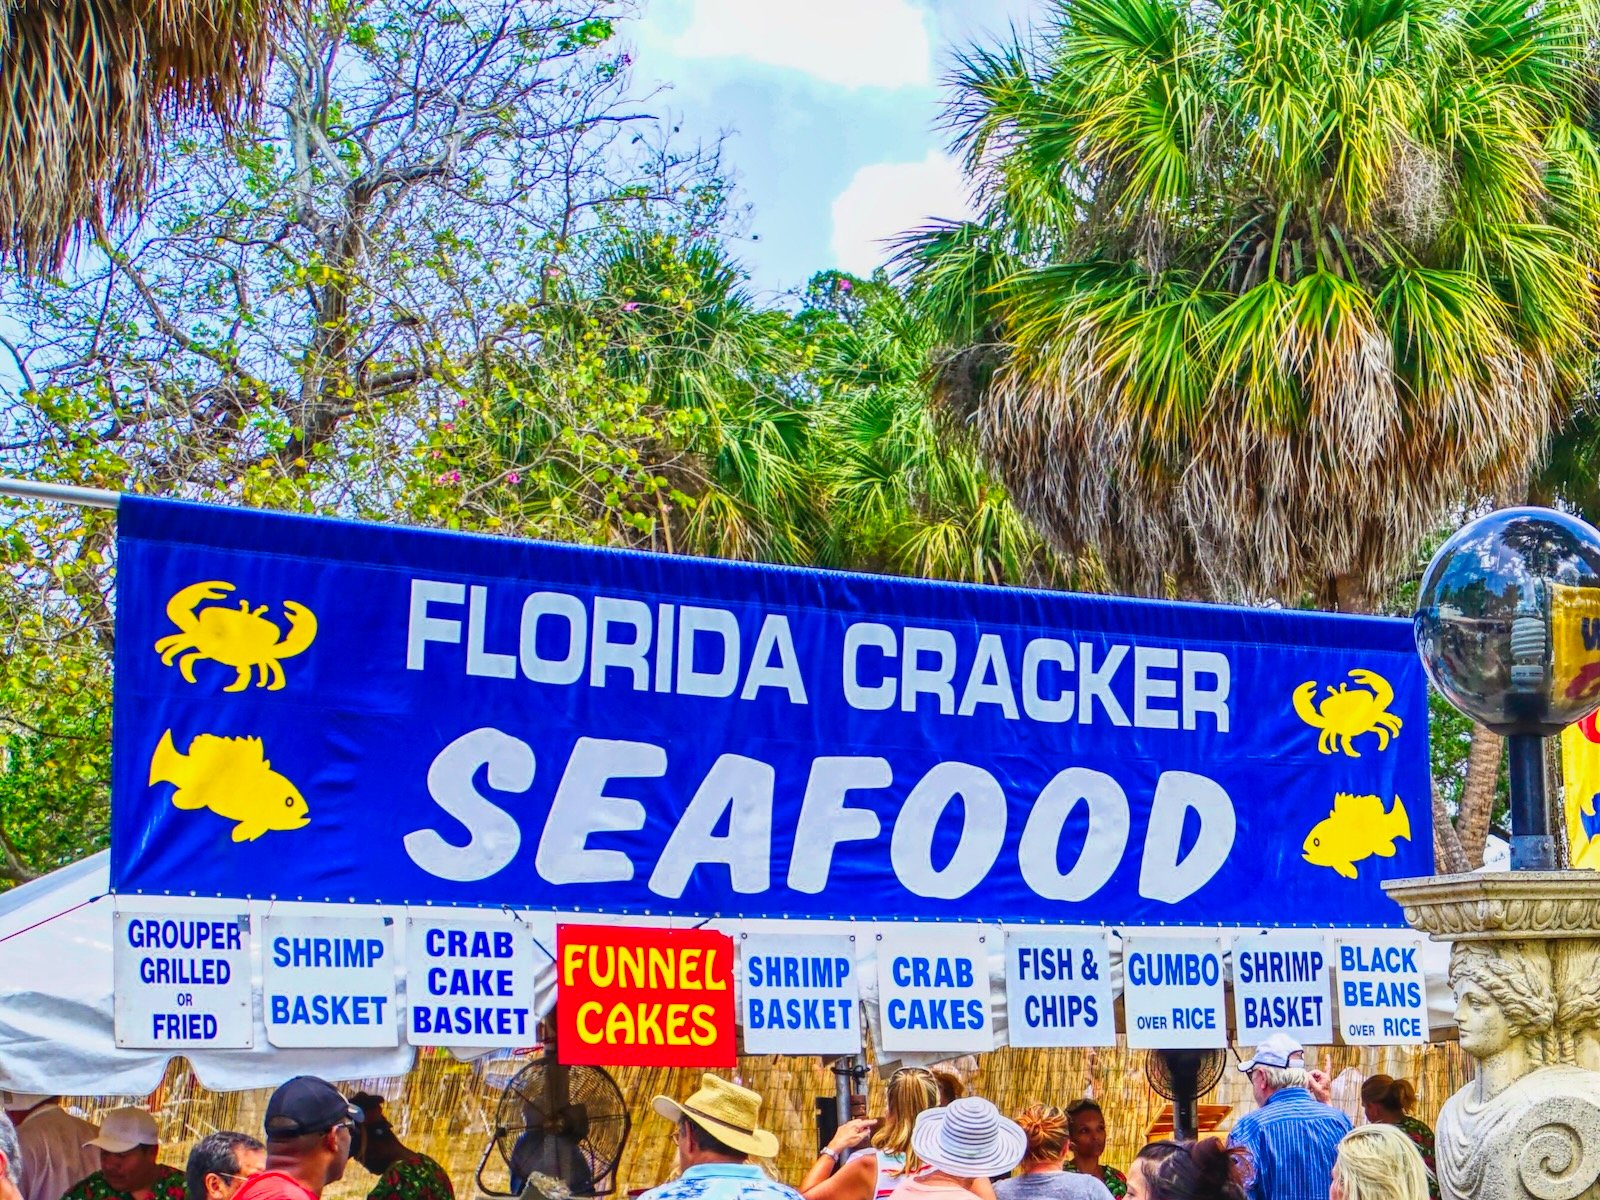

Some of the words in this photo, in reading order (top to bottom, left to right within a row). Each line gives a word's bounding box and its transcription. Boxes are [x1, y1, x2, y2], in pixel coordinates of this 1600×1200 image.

[407, 579, 807, 704] FLORIDA
[844, 623, 1229, 732] CRACKER
[404, 728, 1235, 903] SEAFOOD
[128, 919, 241, 950] GROUPER
[426, 929, 513, 958] CRAB
[273, 937, 384, 967] SHRIMP
[1018, 948, 1073, 980] FISH
[1081, 948, 1098, 980] &
[1341, 946, 1417, 973] BLACK
[140, 957, 230, 984] GRILLED
[428, 967, 513, 996] CAKE
[565, 945, 725, 990] FUNNEL
[749, 956, 849, 988] SHRIMP
[893, 957, 973, 987] CRAB
[1128, 953, 1219, 986] GUMBO
[1240, 952, 1323, 983] SHRIMP
[177, 993, 192, 1006] OR
[1344, 981, 1421, 1008] BEANS
[272, 995, 387, 1025] BASKET
[413, 1006, 528, 1034] BASKET
[577, 1002, 716, 1045] CAKES
[749, 999, 852, 1029] BASKET
[888, 999, 984, 1029] CAKES
[1025, 995, 1098, 1028] CHIPS
[1137, 1016, 1167, 1029] OVER
[1172, 1008, 1215, 1029] RICE
[1244, 996, 1323, 1028] BASKET
[153, 1014, 217, 1039] FRIED
[1350, 1025, 1374, 1036] OVER
[1384, 1018, 1421, 1037] RICE
